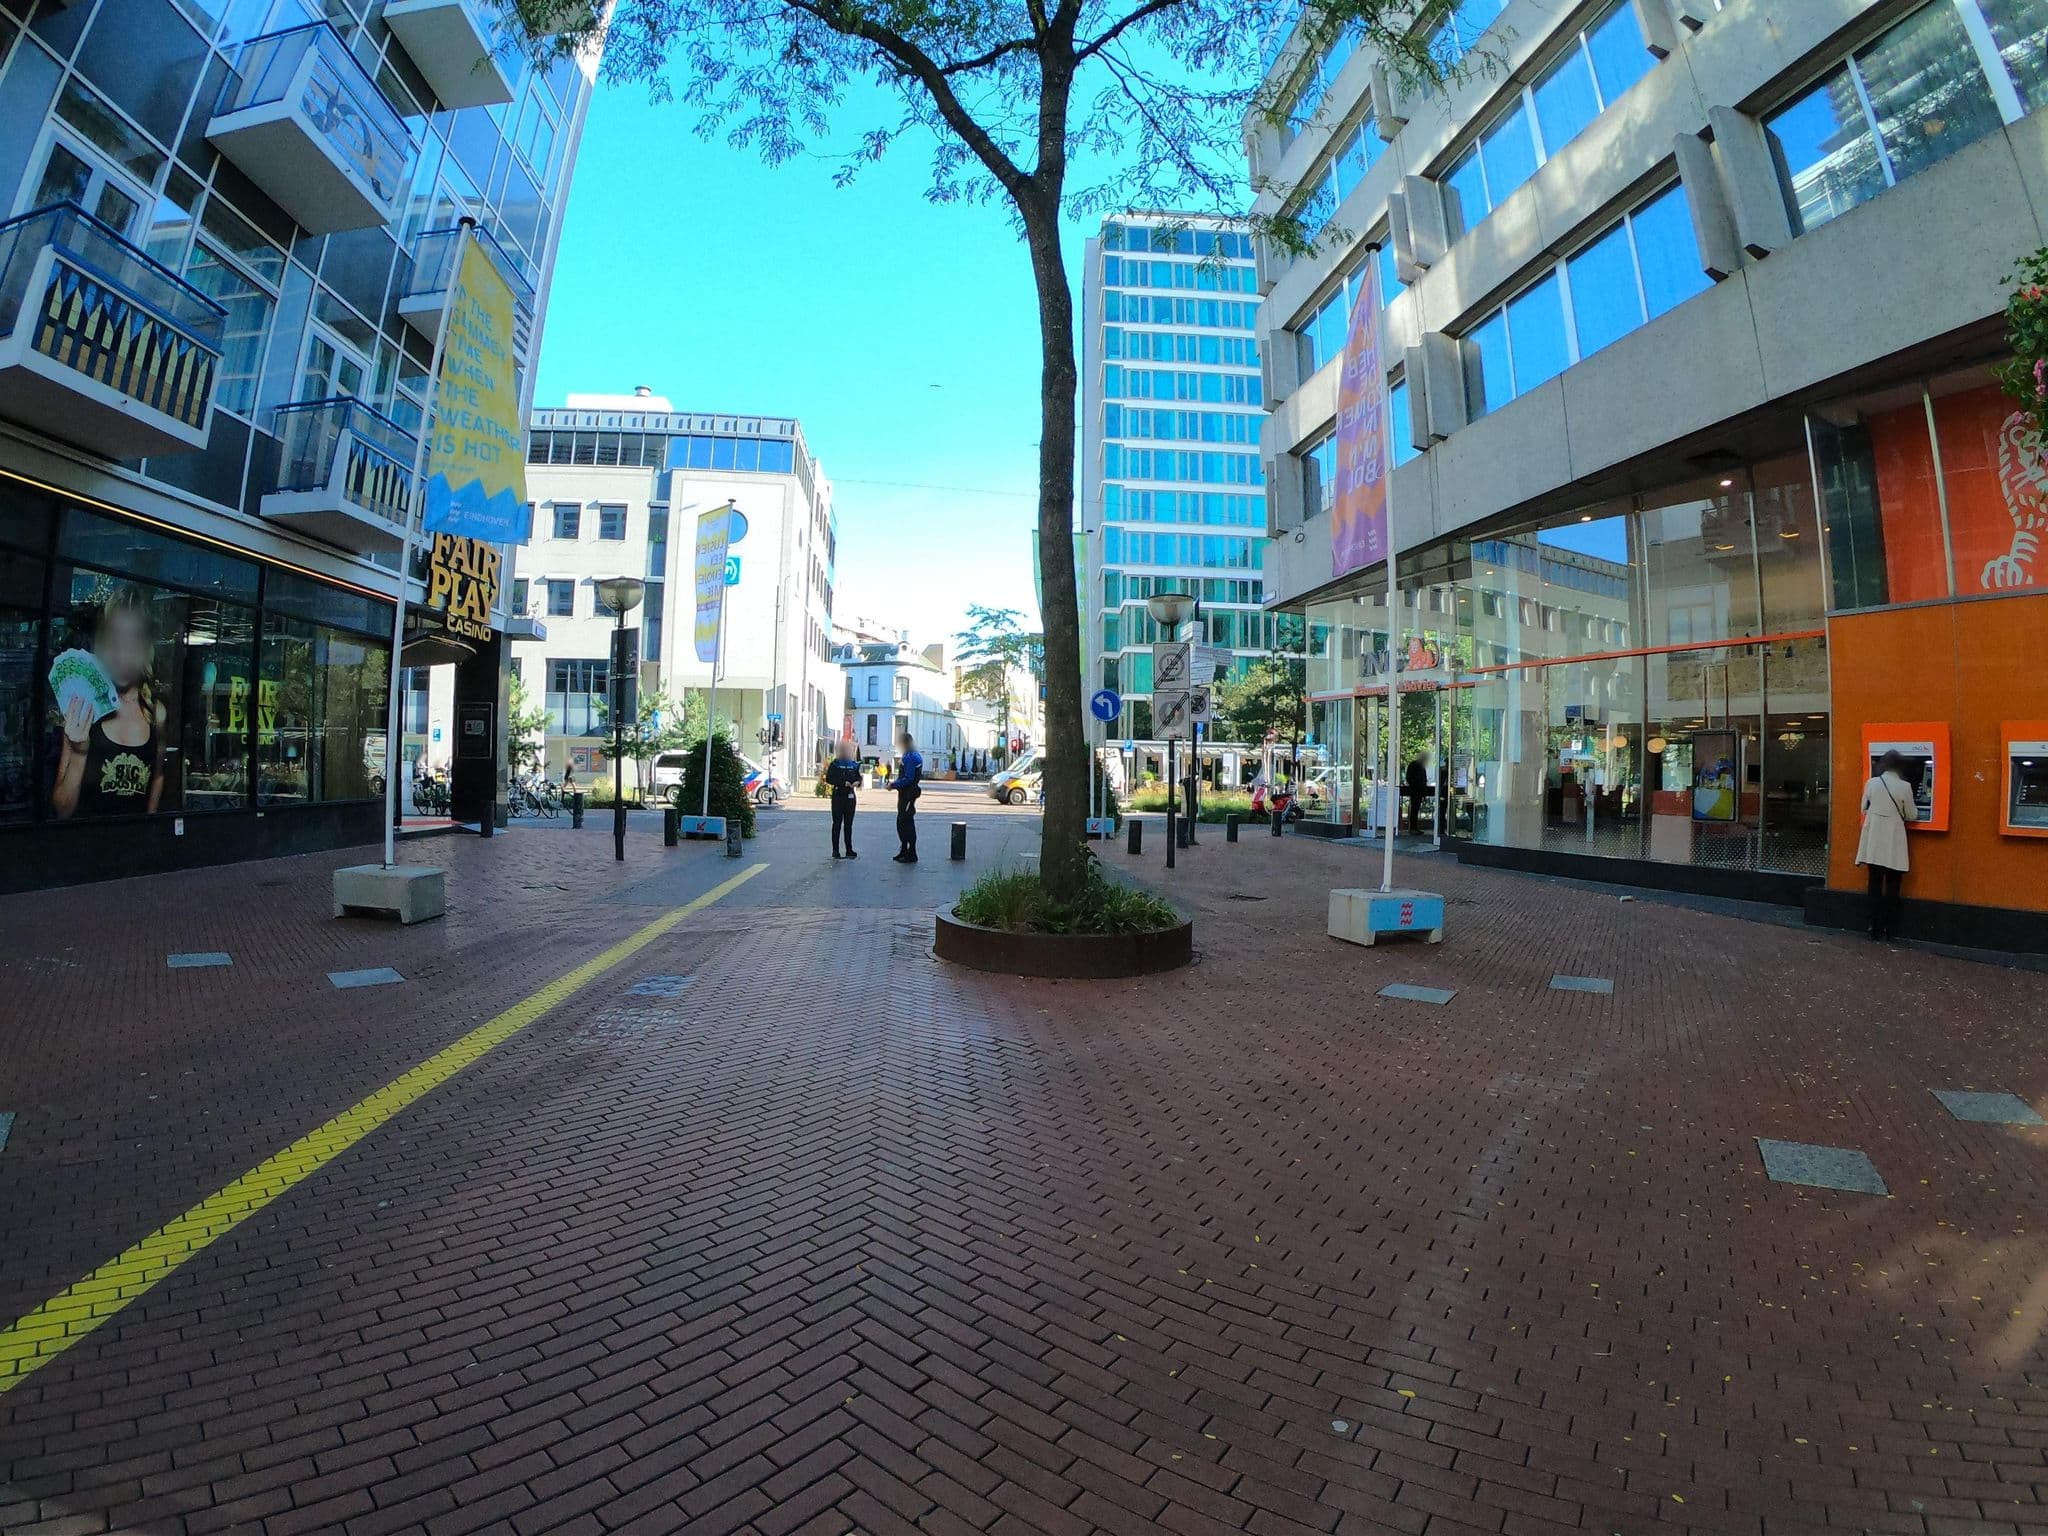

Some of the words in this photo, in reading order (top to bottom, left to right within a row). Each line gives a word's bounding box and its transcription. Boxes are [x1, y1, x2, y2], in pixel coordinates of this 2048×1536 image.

[447, 356, 495, 392] WHEN
[445, 380, 480, 407] THE
[438, 407, 521, 452] WEATHER
[436, 433, 455, 455] IS
[464, 438, 502, 464] HOT
[464, 511, 510, 527] EINDHOVEN
[433, 532, 501, 589] FAIR
[428, 565, 499, 625] PLAY
[447, 615, 492, 643] CASINO
